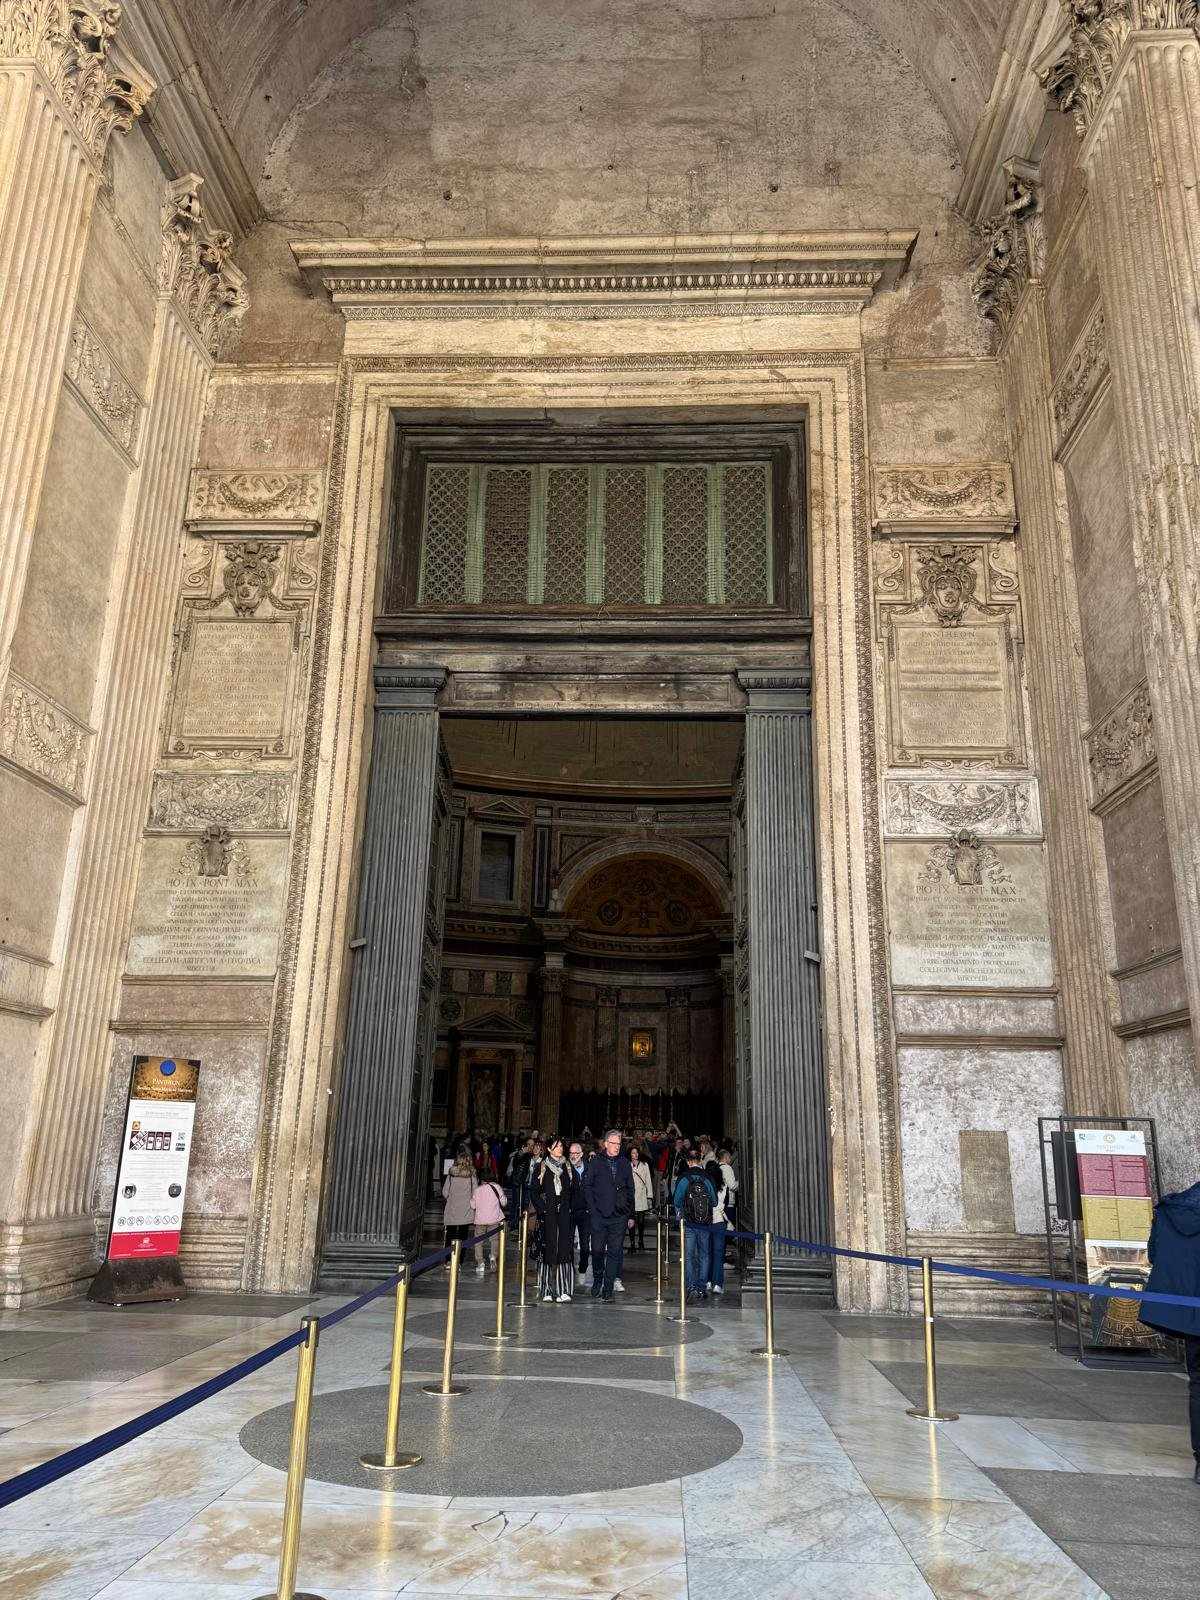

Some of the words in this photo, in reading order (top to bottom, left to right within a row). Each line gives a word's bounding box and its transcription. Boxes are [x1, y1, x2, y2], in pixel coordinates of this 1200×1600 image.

[166, 878, 181, 888] PIO
[186, 878, 197, 888] IX
[204, 878, 229, 888] PONT
[235, 878, 259, 888] MAX
[915, 885, 932, 894] PIO
[938, 885, 950, 894] IX
[957, 885, 984, 895] PONT
[991, 886, 1016, 895] MAX
